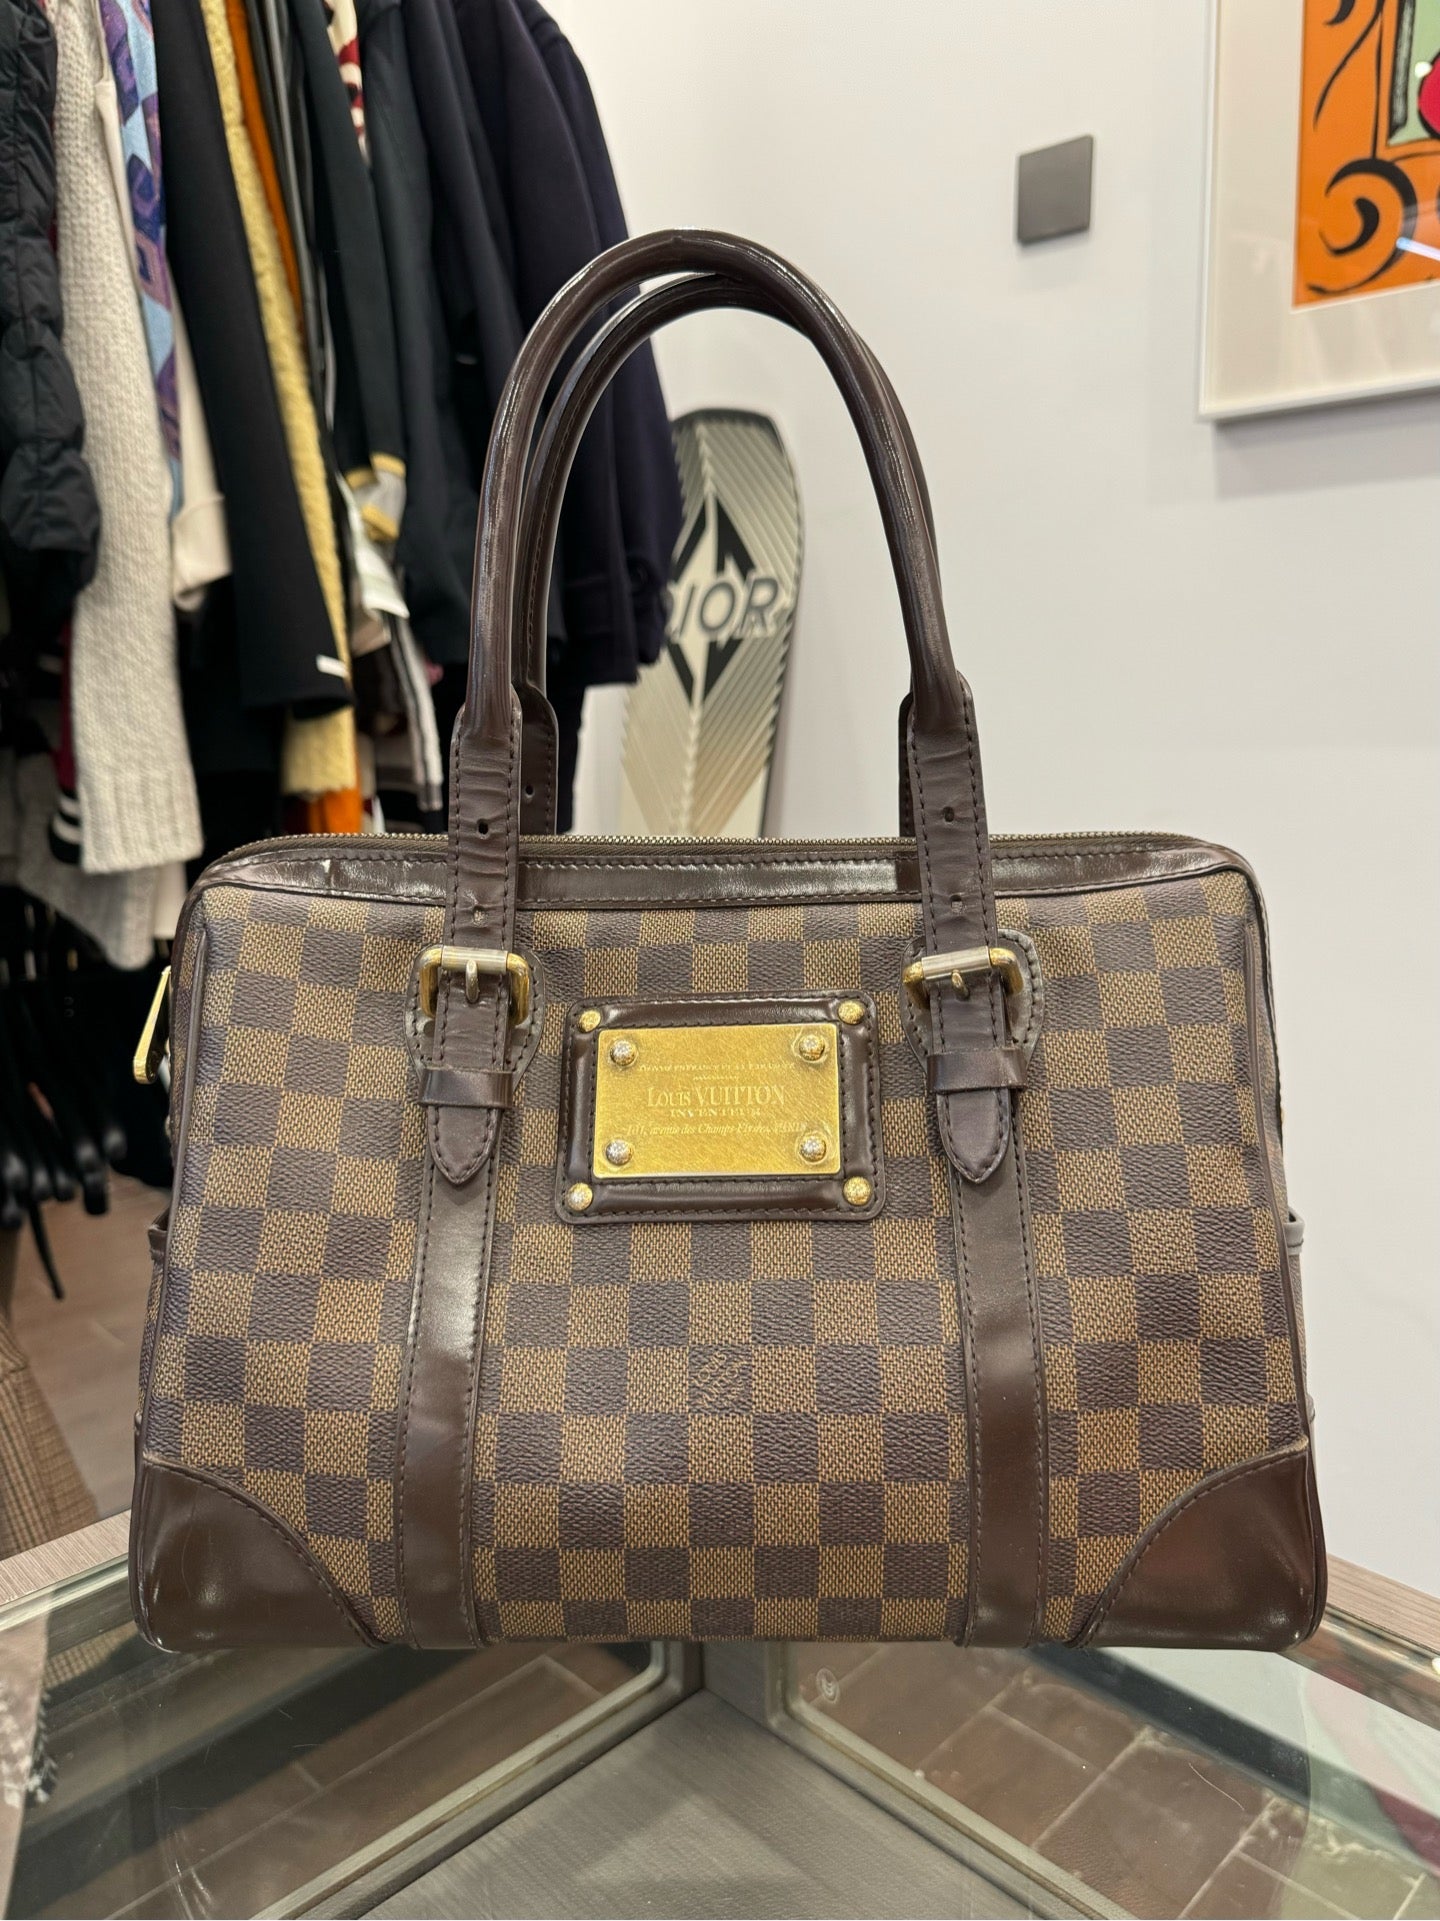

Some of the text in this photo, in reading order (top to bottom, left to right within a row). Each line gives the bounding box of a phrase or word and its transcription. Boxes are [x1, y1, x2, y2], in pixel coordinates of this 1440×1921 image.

[667, 577, 779, 638] IOR
[695, 1084, 786, 1106] VUITTON
[670, 1107, 761, 1118] INVENTEUR
